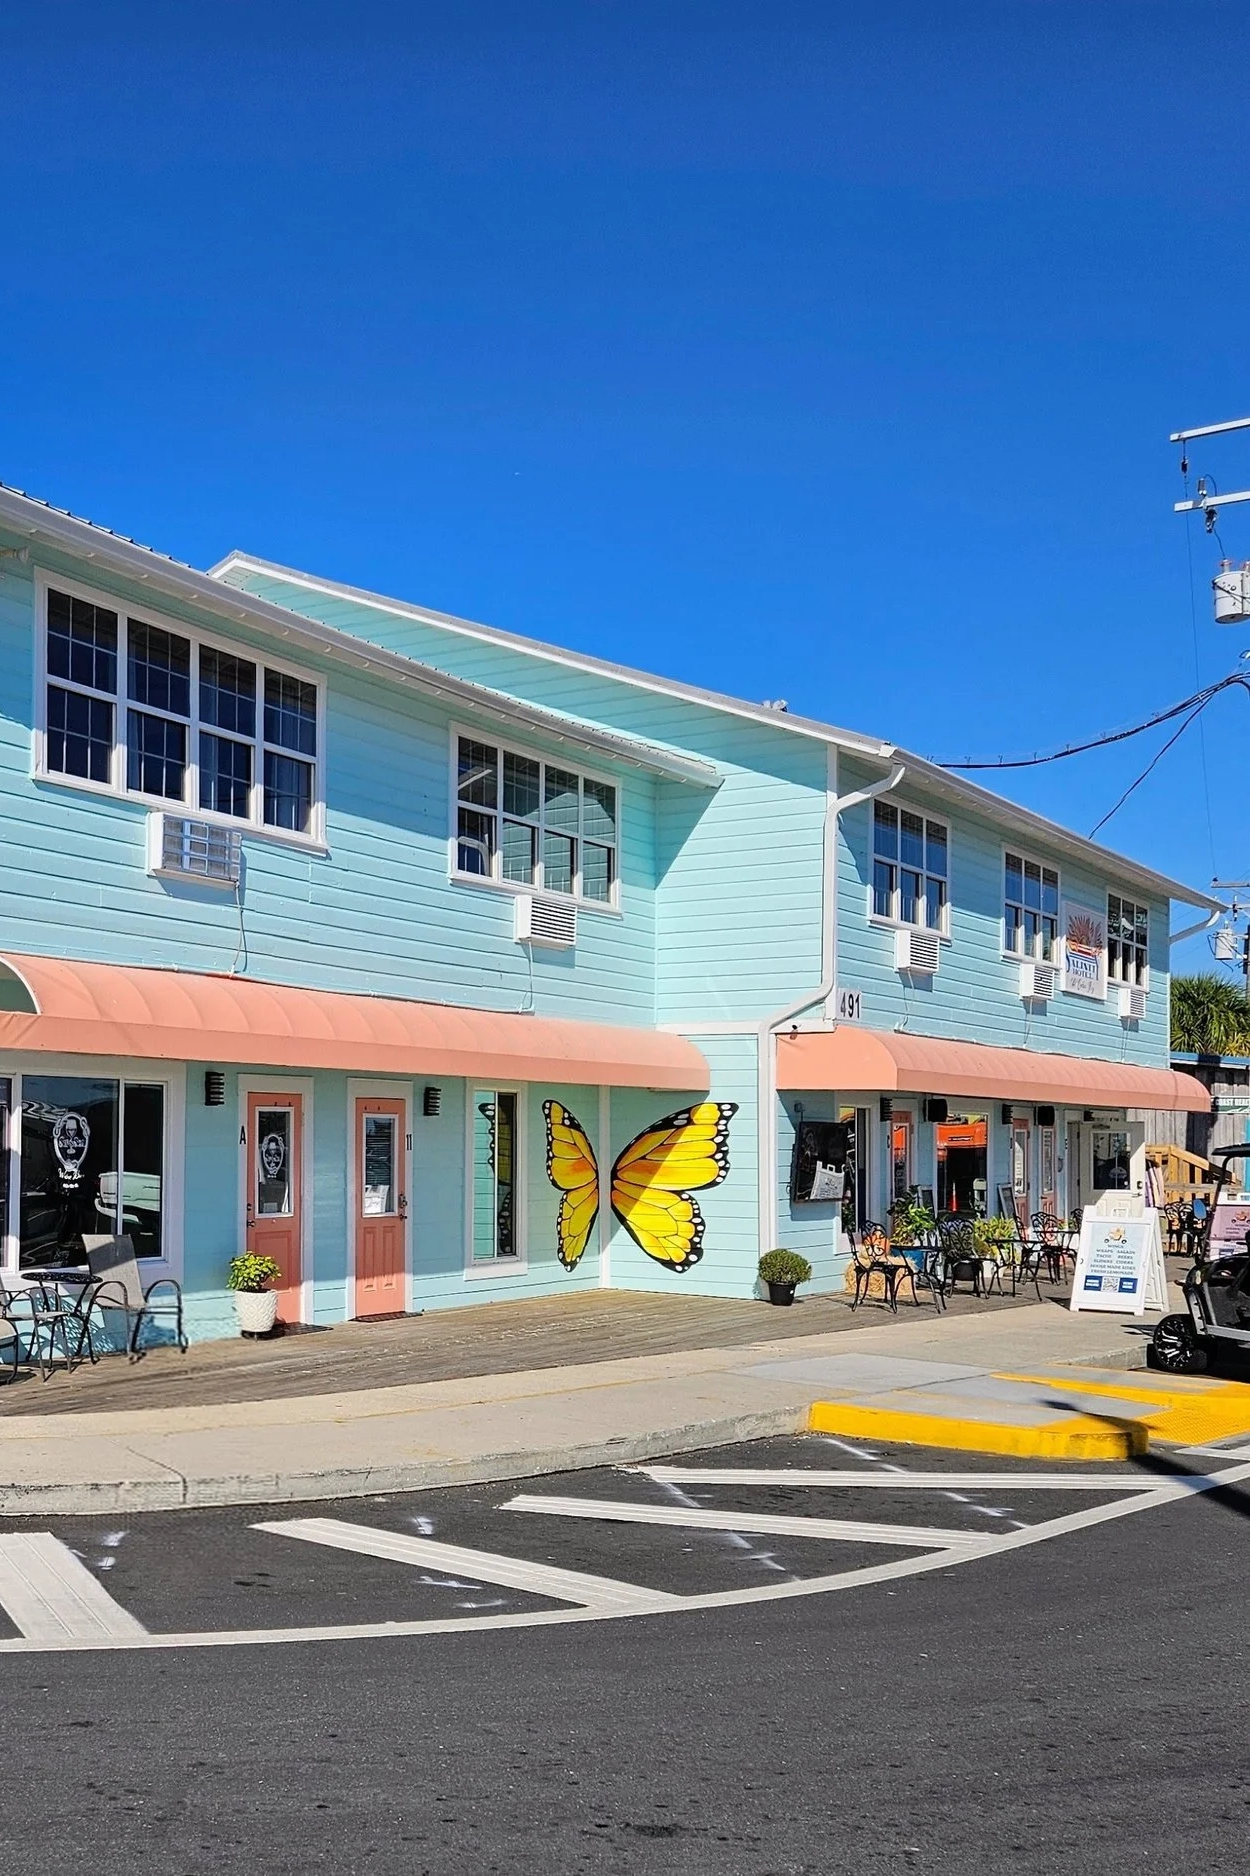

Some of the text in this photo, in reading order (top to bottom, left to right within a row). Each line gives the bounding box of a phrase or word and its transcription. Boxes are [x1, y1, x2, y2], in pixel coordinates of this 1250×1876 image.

[840, 992, 860, 1018] 491
[239, 1125, 247, 1145] A
[406, 1133, 412, 1151] 11
